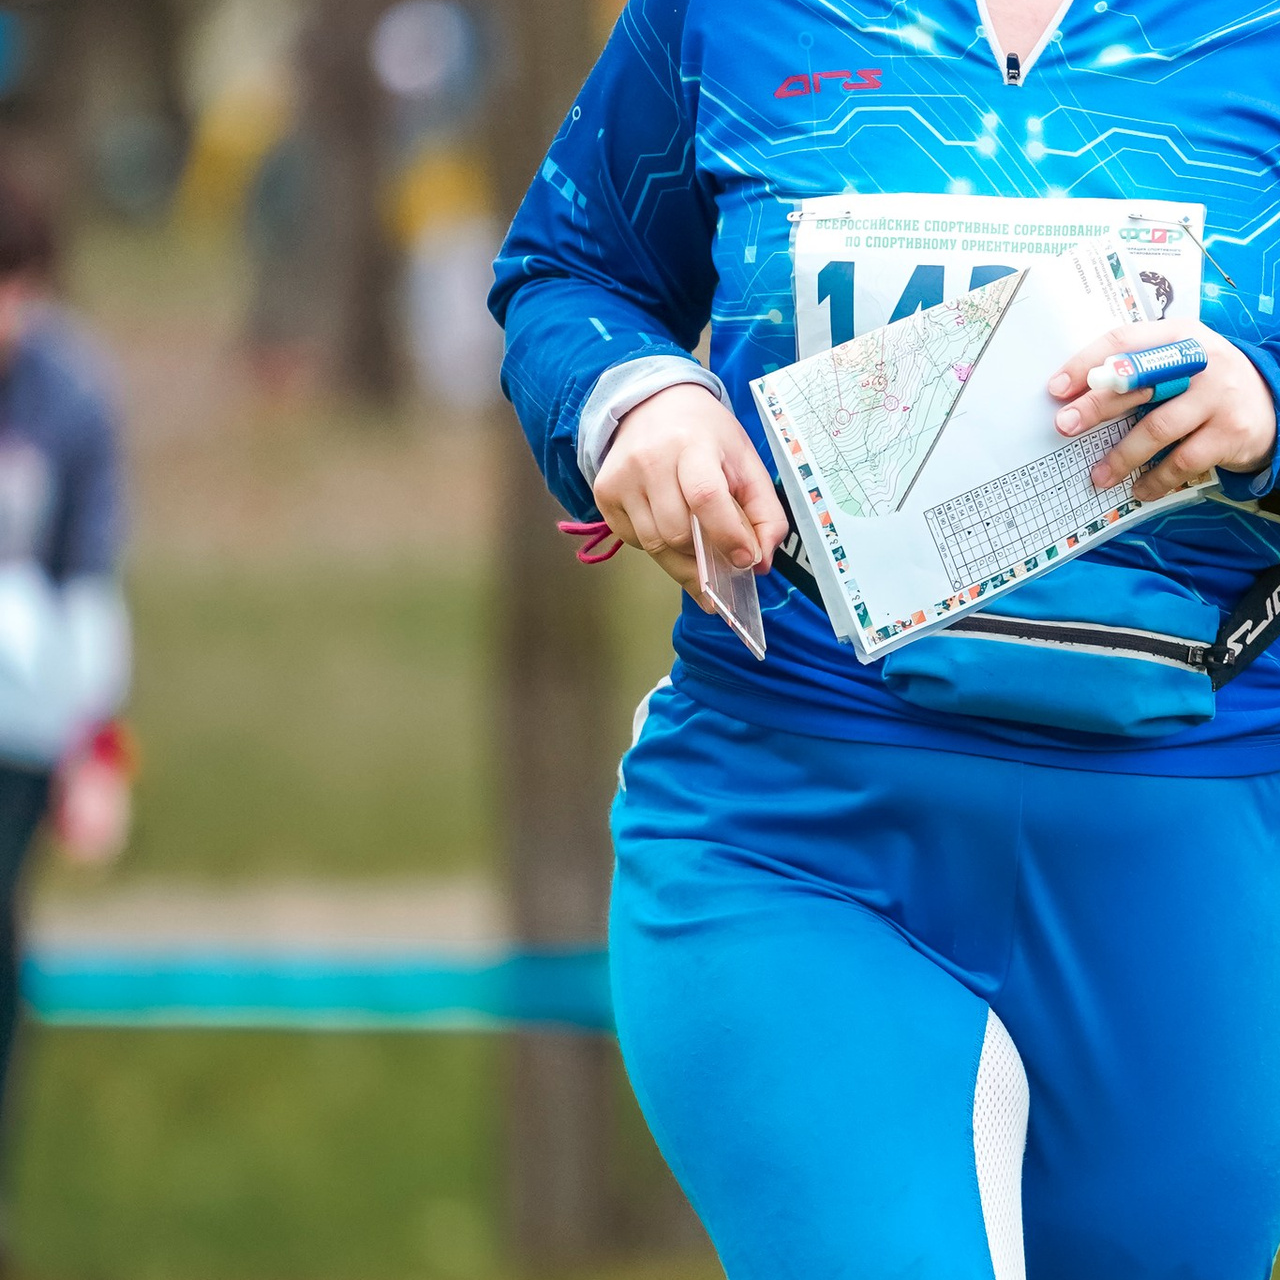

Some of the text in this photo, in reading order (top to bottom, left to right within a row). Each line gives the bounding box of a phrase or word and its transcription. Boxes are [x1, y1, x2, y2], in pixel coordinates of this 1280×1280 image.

[816, 217, 1110, 237] ВСЕРОССИЙСКИЕ СПОРТИВНЫЕ СОРЕВНОВАНИЯ
[845, 236, 861, 247] ПО
[865, 236, 957, 250] СПОРТИВНОМУ
[953, 313, 965, 326] 12
[860, 379, 870, 388] 3
[900, 403, 911, 413] 4
[831, 428, 841, 437] 5
[1019, 468, 1030, 486] 10 38
[1032, 474, 1039, 482] 39
[1041, 470, 1048, 478] 40
[991, 481, 998, 489] 13
[1000, 477, 1011, 495] 12 37
[963, 494, 974, 512] 16 82
[973, 490, 984, 508] 15 60
[954, 498, 965, 516] 17 54
[935, 507, 946, 525] 19 90
